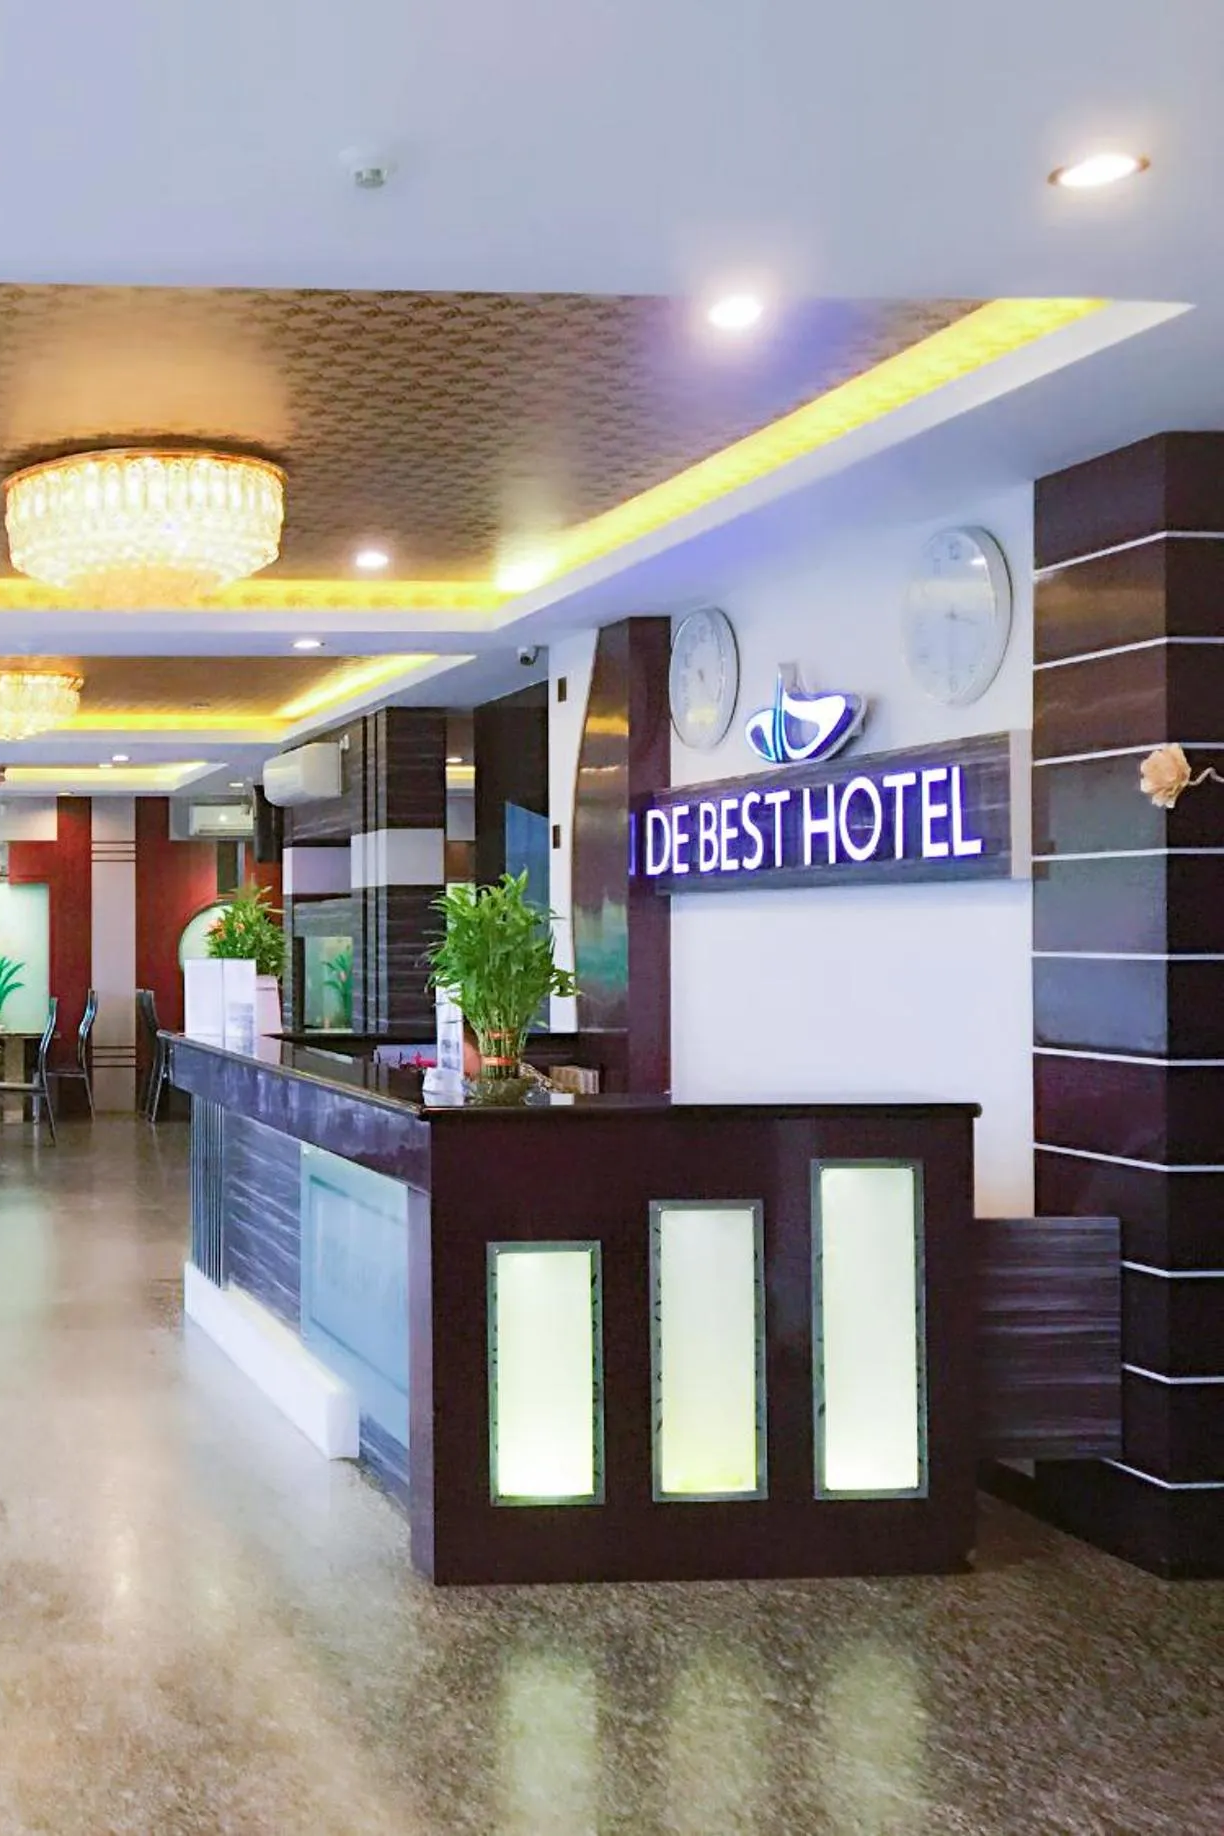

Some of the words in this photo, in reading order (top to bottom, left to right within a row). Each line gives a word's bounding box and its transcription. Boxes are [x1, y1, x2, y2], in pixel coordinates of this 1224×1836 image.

[645, 804, 690, 876] DE
[699, 790, 791, 872] BEST
[802, 766, 983, 867] HOTEL
